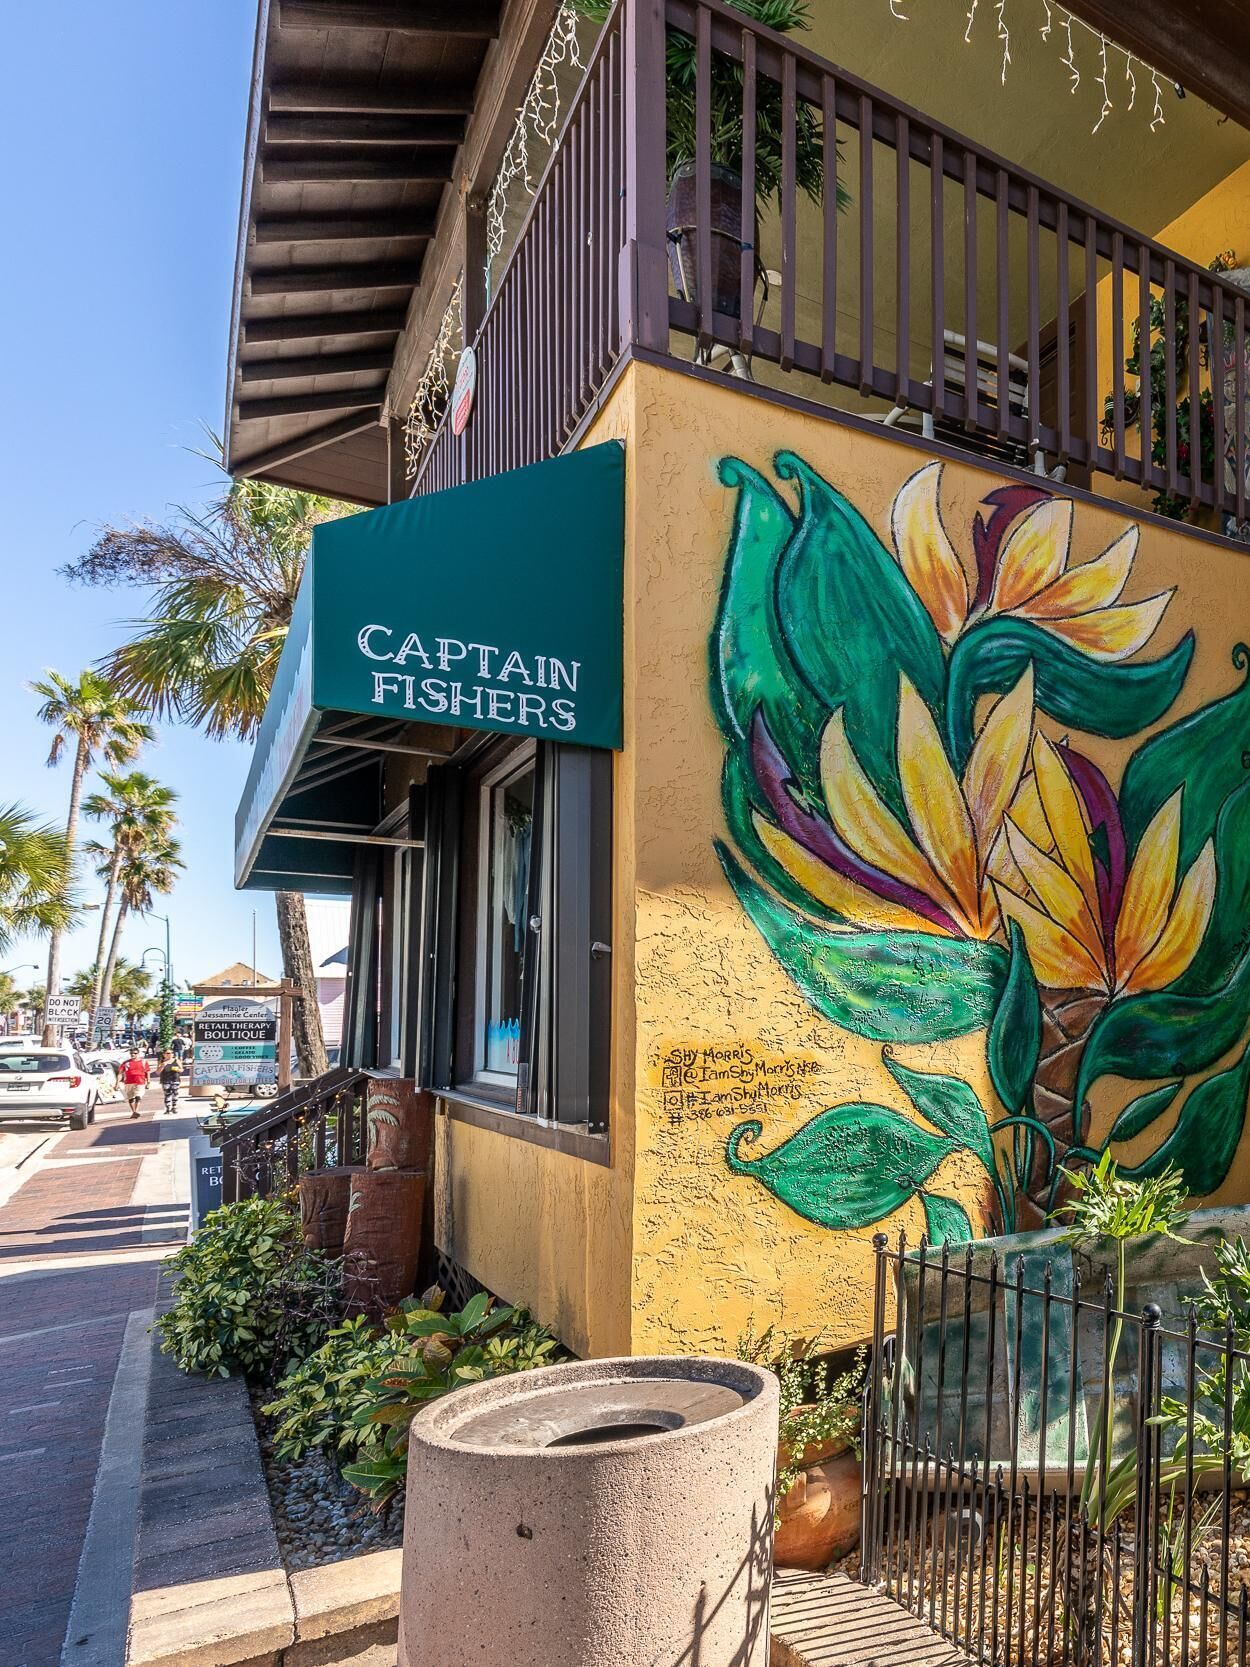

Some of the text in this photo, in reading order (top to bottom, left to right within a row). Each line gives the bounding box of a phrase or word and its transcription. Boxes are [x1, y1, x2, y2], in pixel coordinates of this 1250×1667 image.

[357, 624, 581, 692] CAPTAIN
[371, 671, 577, 732] FISHERS
[63, 999, 80, 1007] NOT
[48, 1008, 79, 1016] BLOCK
[222, 1005, 248, 1013] Flagler
[198, 1022, 230, 1030] RETAIL
[204, 1030, 266, 1040] BOUTIQUE
[195, 1064, 274, 1076] CAPTAIN FISHERS
